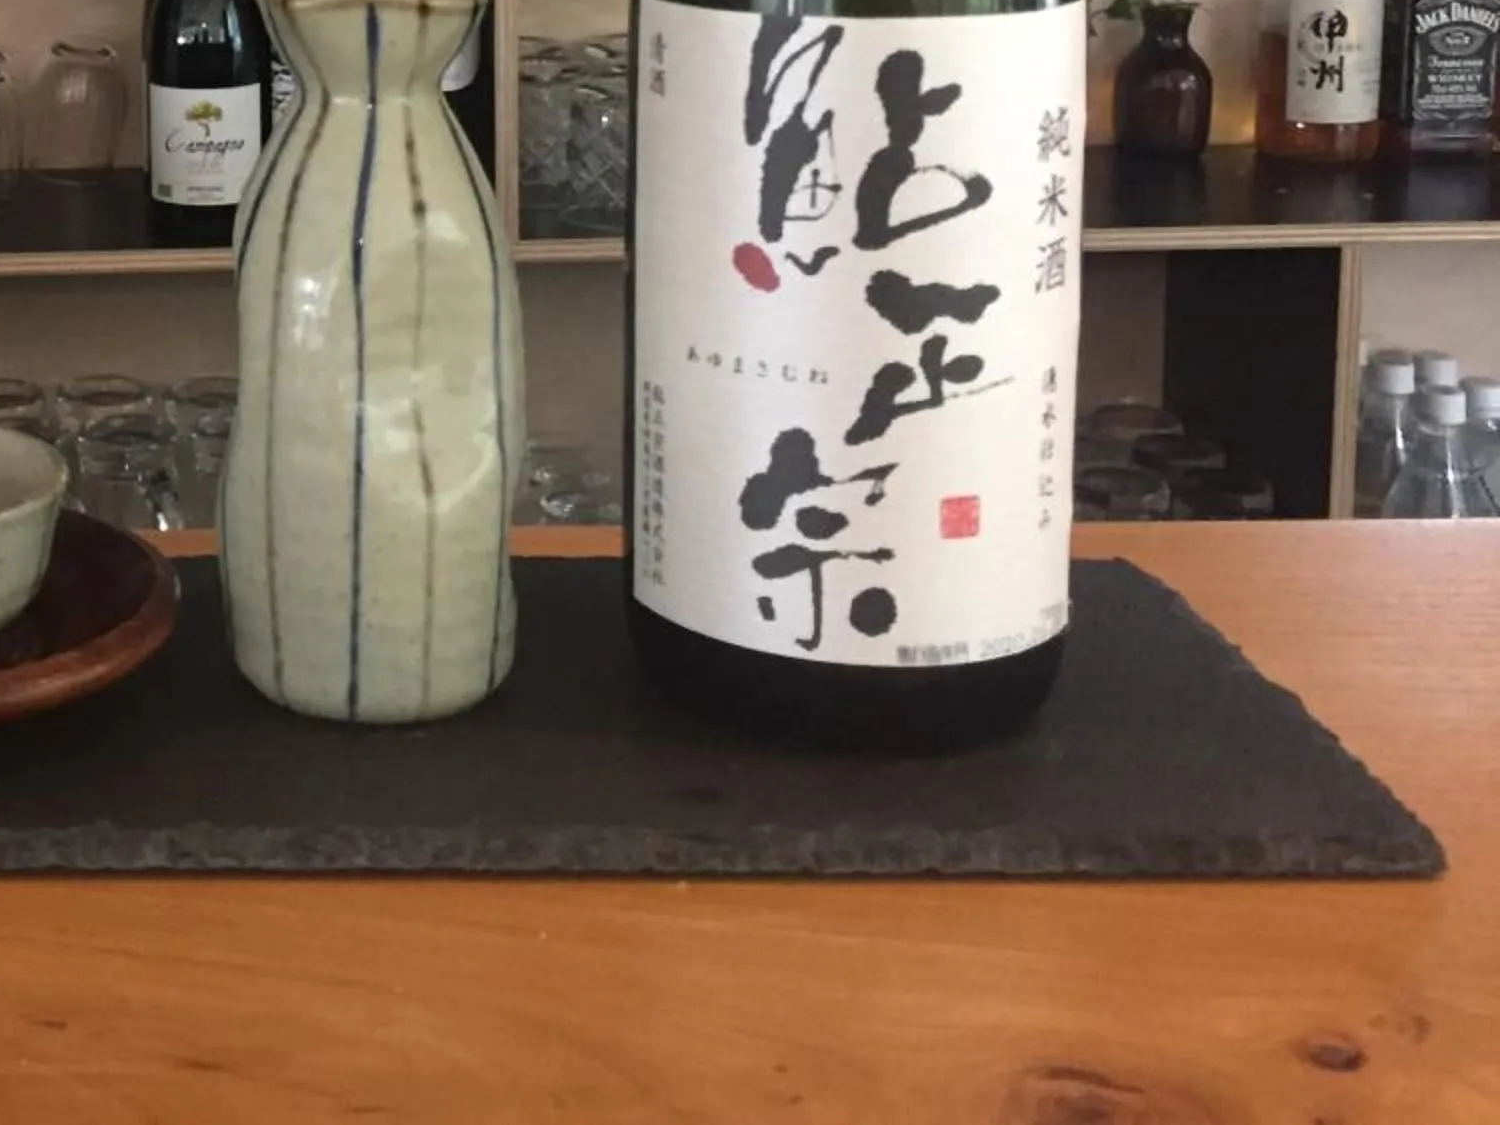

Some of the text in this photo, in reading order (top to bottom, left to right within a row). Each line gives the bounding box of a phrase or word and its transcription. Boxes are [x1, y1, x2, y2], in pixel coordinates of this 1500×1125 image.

[1415, 8, 1450, 34] JACK
[1035, 106, 1071, 295] 純米酒
